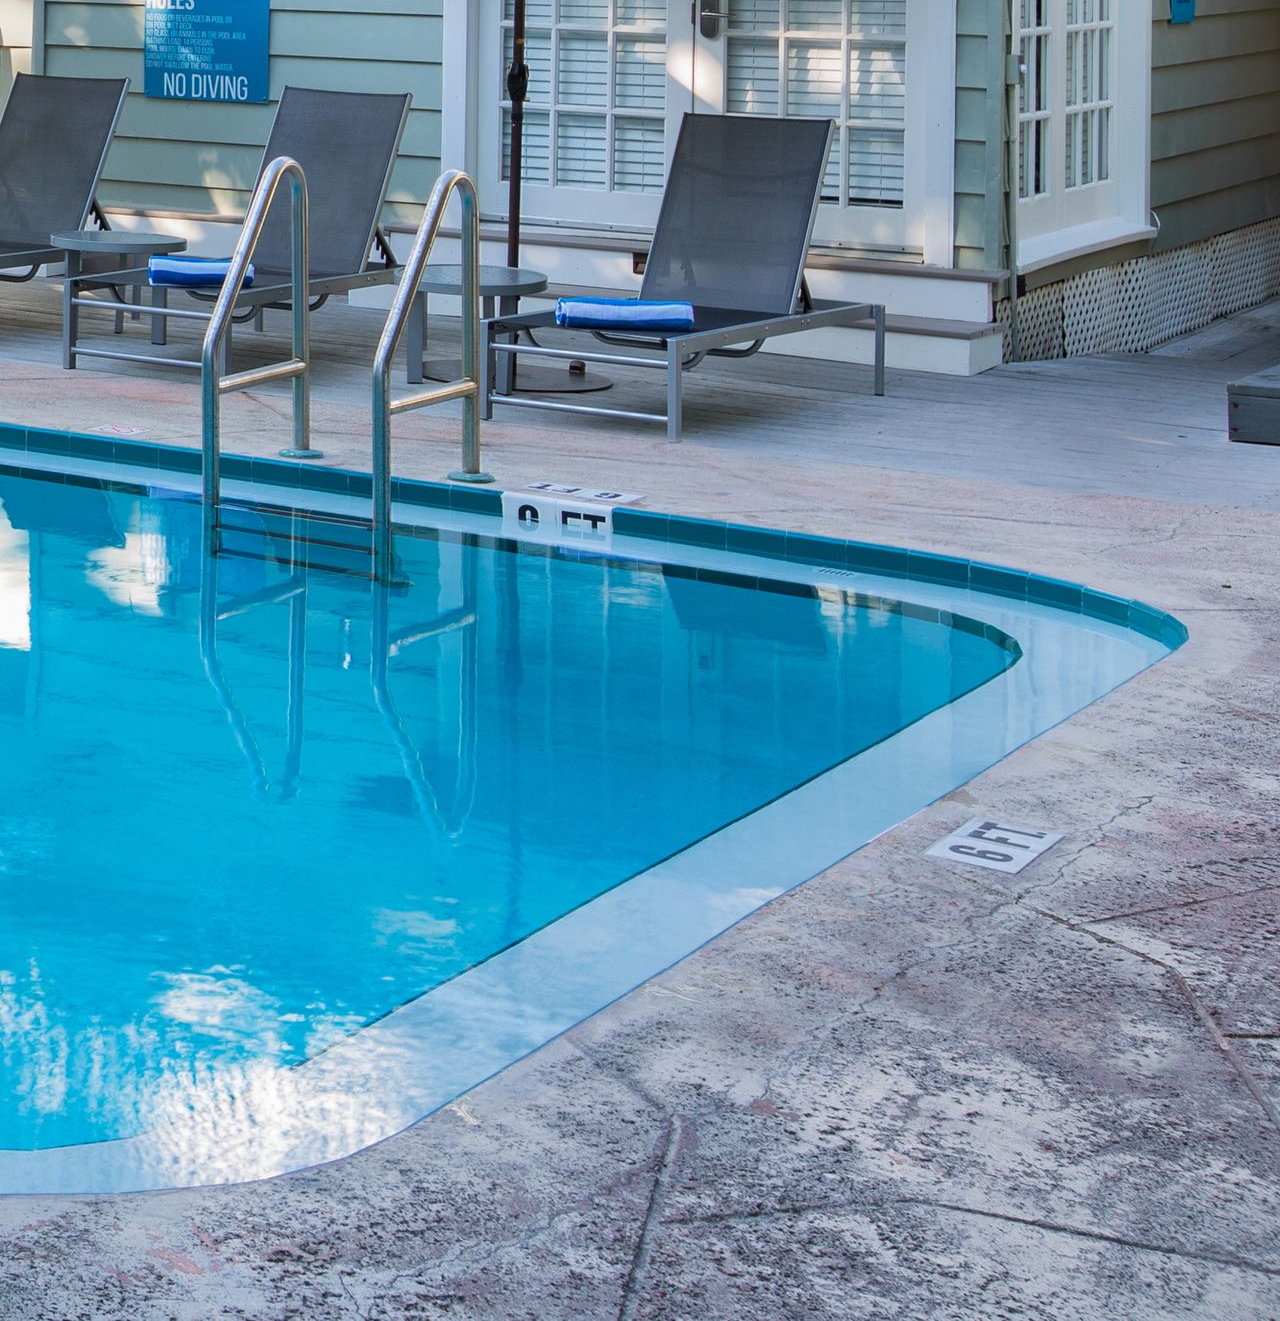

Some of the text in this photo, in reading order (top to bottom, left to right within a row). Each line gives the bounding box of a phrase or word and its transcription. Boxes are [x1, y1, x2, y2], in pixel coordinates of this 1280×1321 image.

[176, 14, 205, 23] BEVERAGES
[154, 29, 169, 37] GLASS
[201, 62, 213, 70] POOL
[163, 72, 248, 101] NO DIVING
[948, 844, 1014, 862] 6
